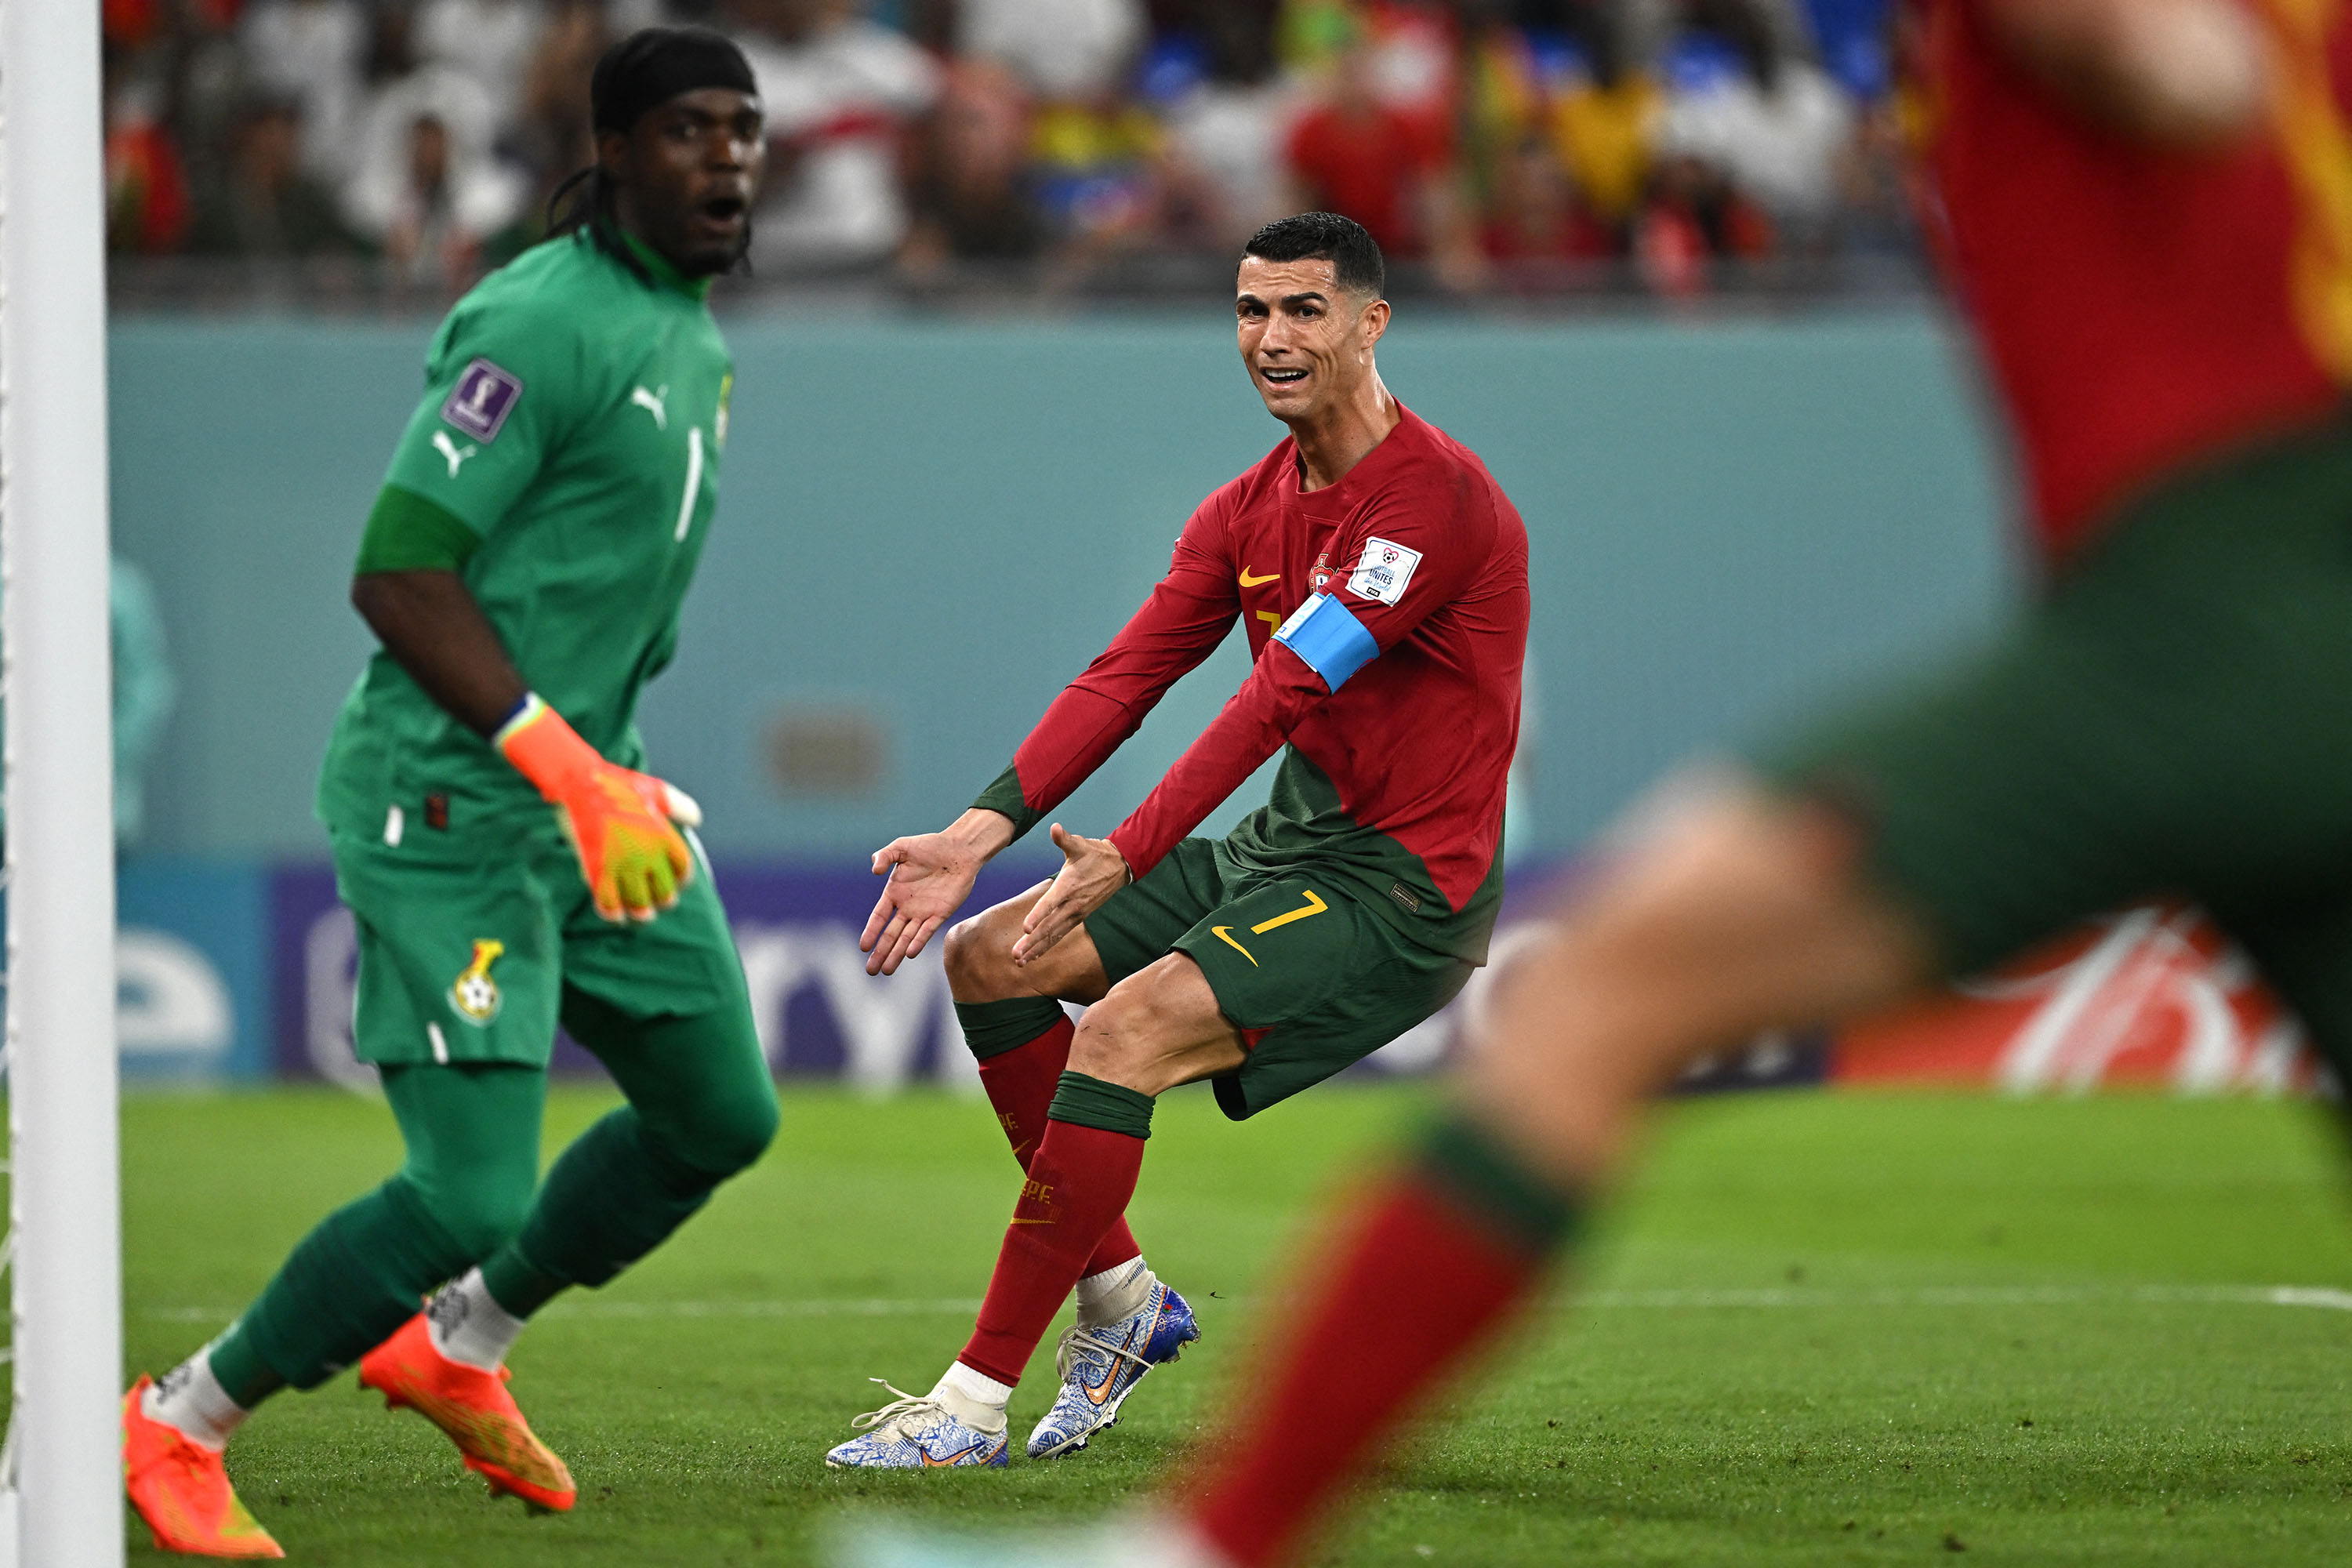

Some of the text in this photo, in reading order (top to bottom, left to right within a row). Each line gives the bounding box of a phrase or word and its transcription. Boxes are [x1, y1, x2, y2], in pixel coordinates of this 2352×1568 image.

[674, 426, 703, 543] 1
[1369, 568, 1393, 585] UNITES
[1256, 609, 1281, 640] 7
[1250, 889, 1328, 935] 7
